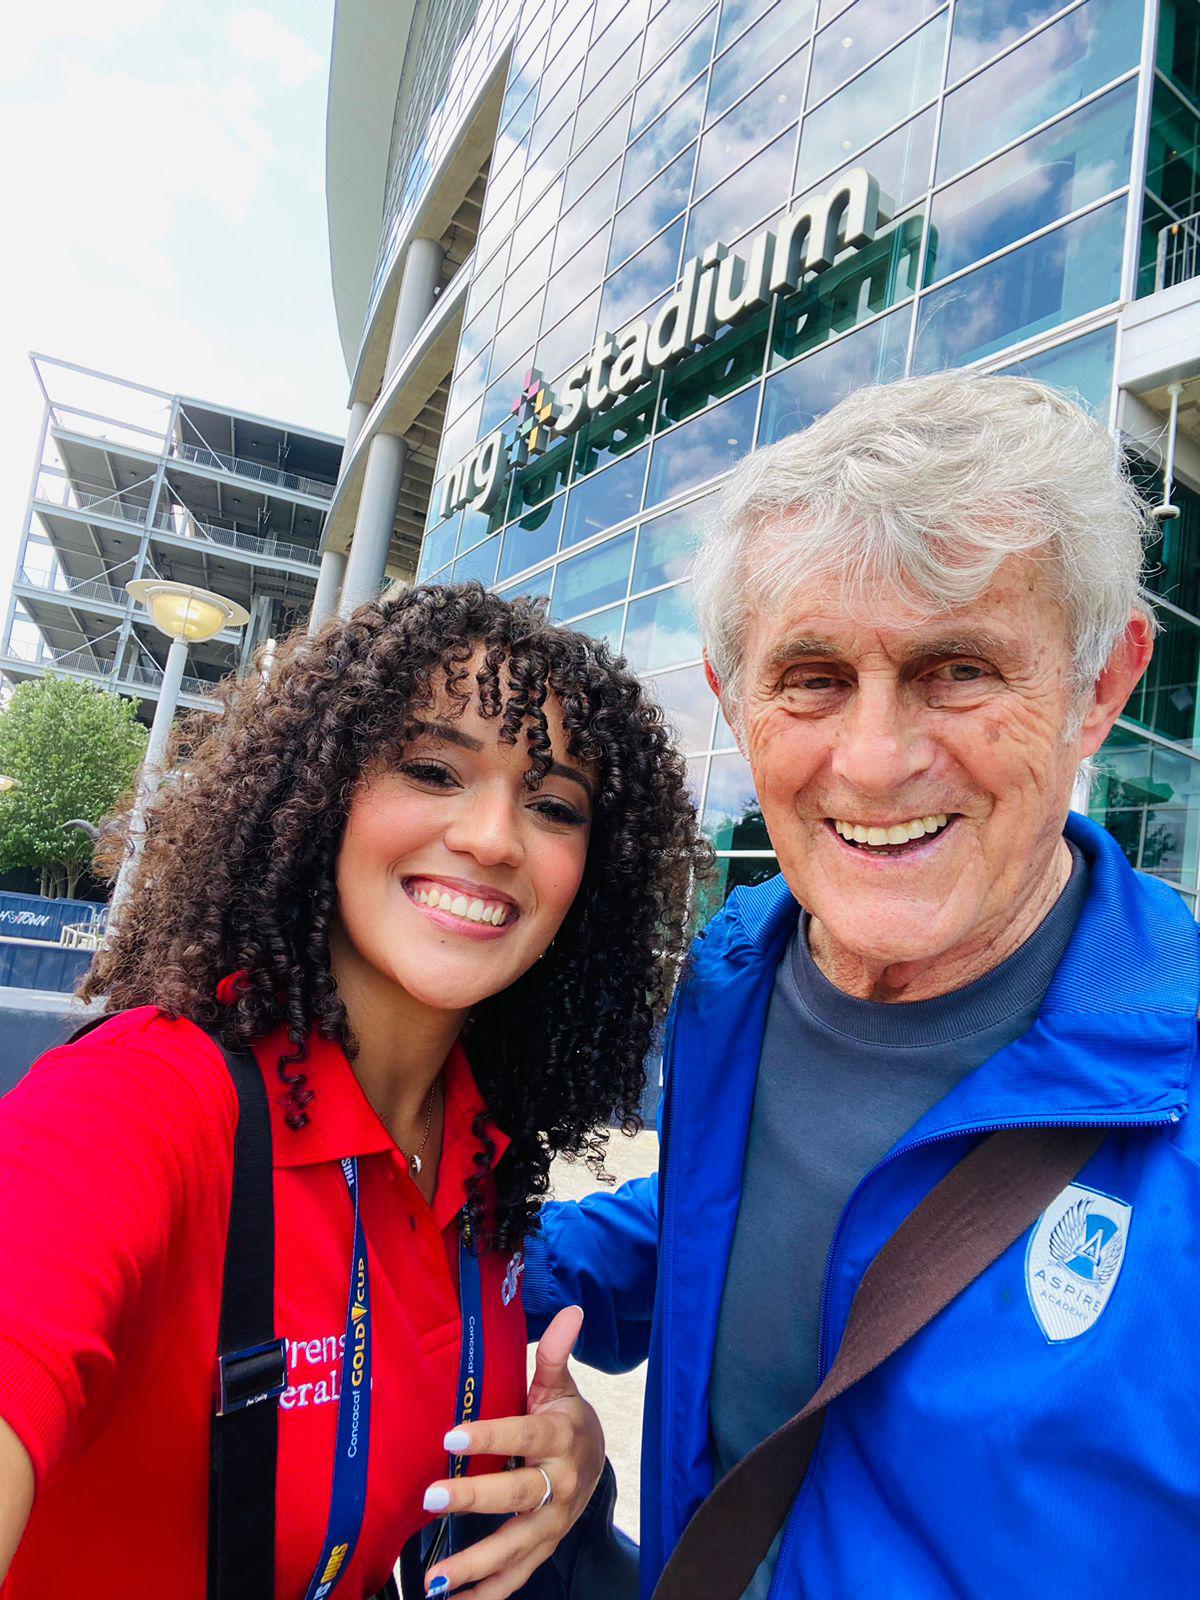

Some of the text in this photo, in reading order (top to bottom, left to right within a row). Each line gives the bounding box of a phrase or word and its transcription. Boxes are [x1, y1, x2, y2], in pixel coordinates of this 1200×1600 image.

[440, 166, 878, 517] nrg stadium
[1034, 1269, 1101, 1313] ASPIRE
[1039, 1290, 1089, 1320] ACADEMY
[351, 1322, 366, 1387] GOLD
[468, 1316, 476, 1374] Concacaf
[347, 1390, 361, 1458] Concacaf
[462, 1376, 475, 1424] GOL
